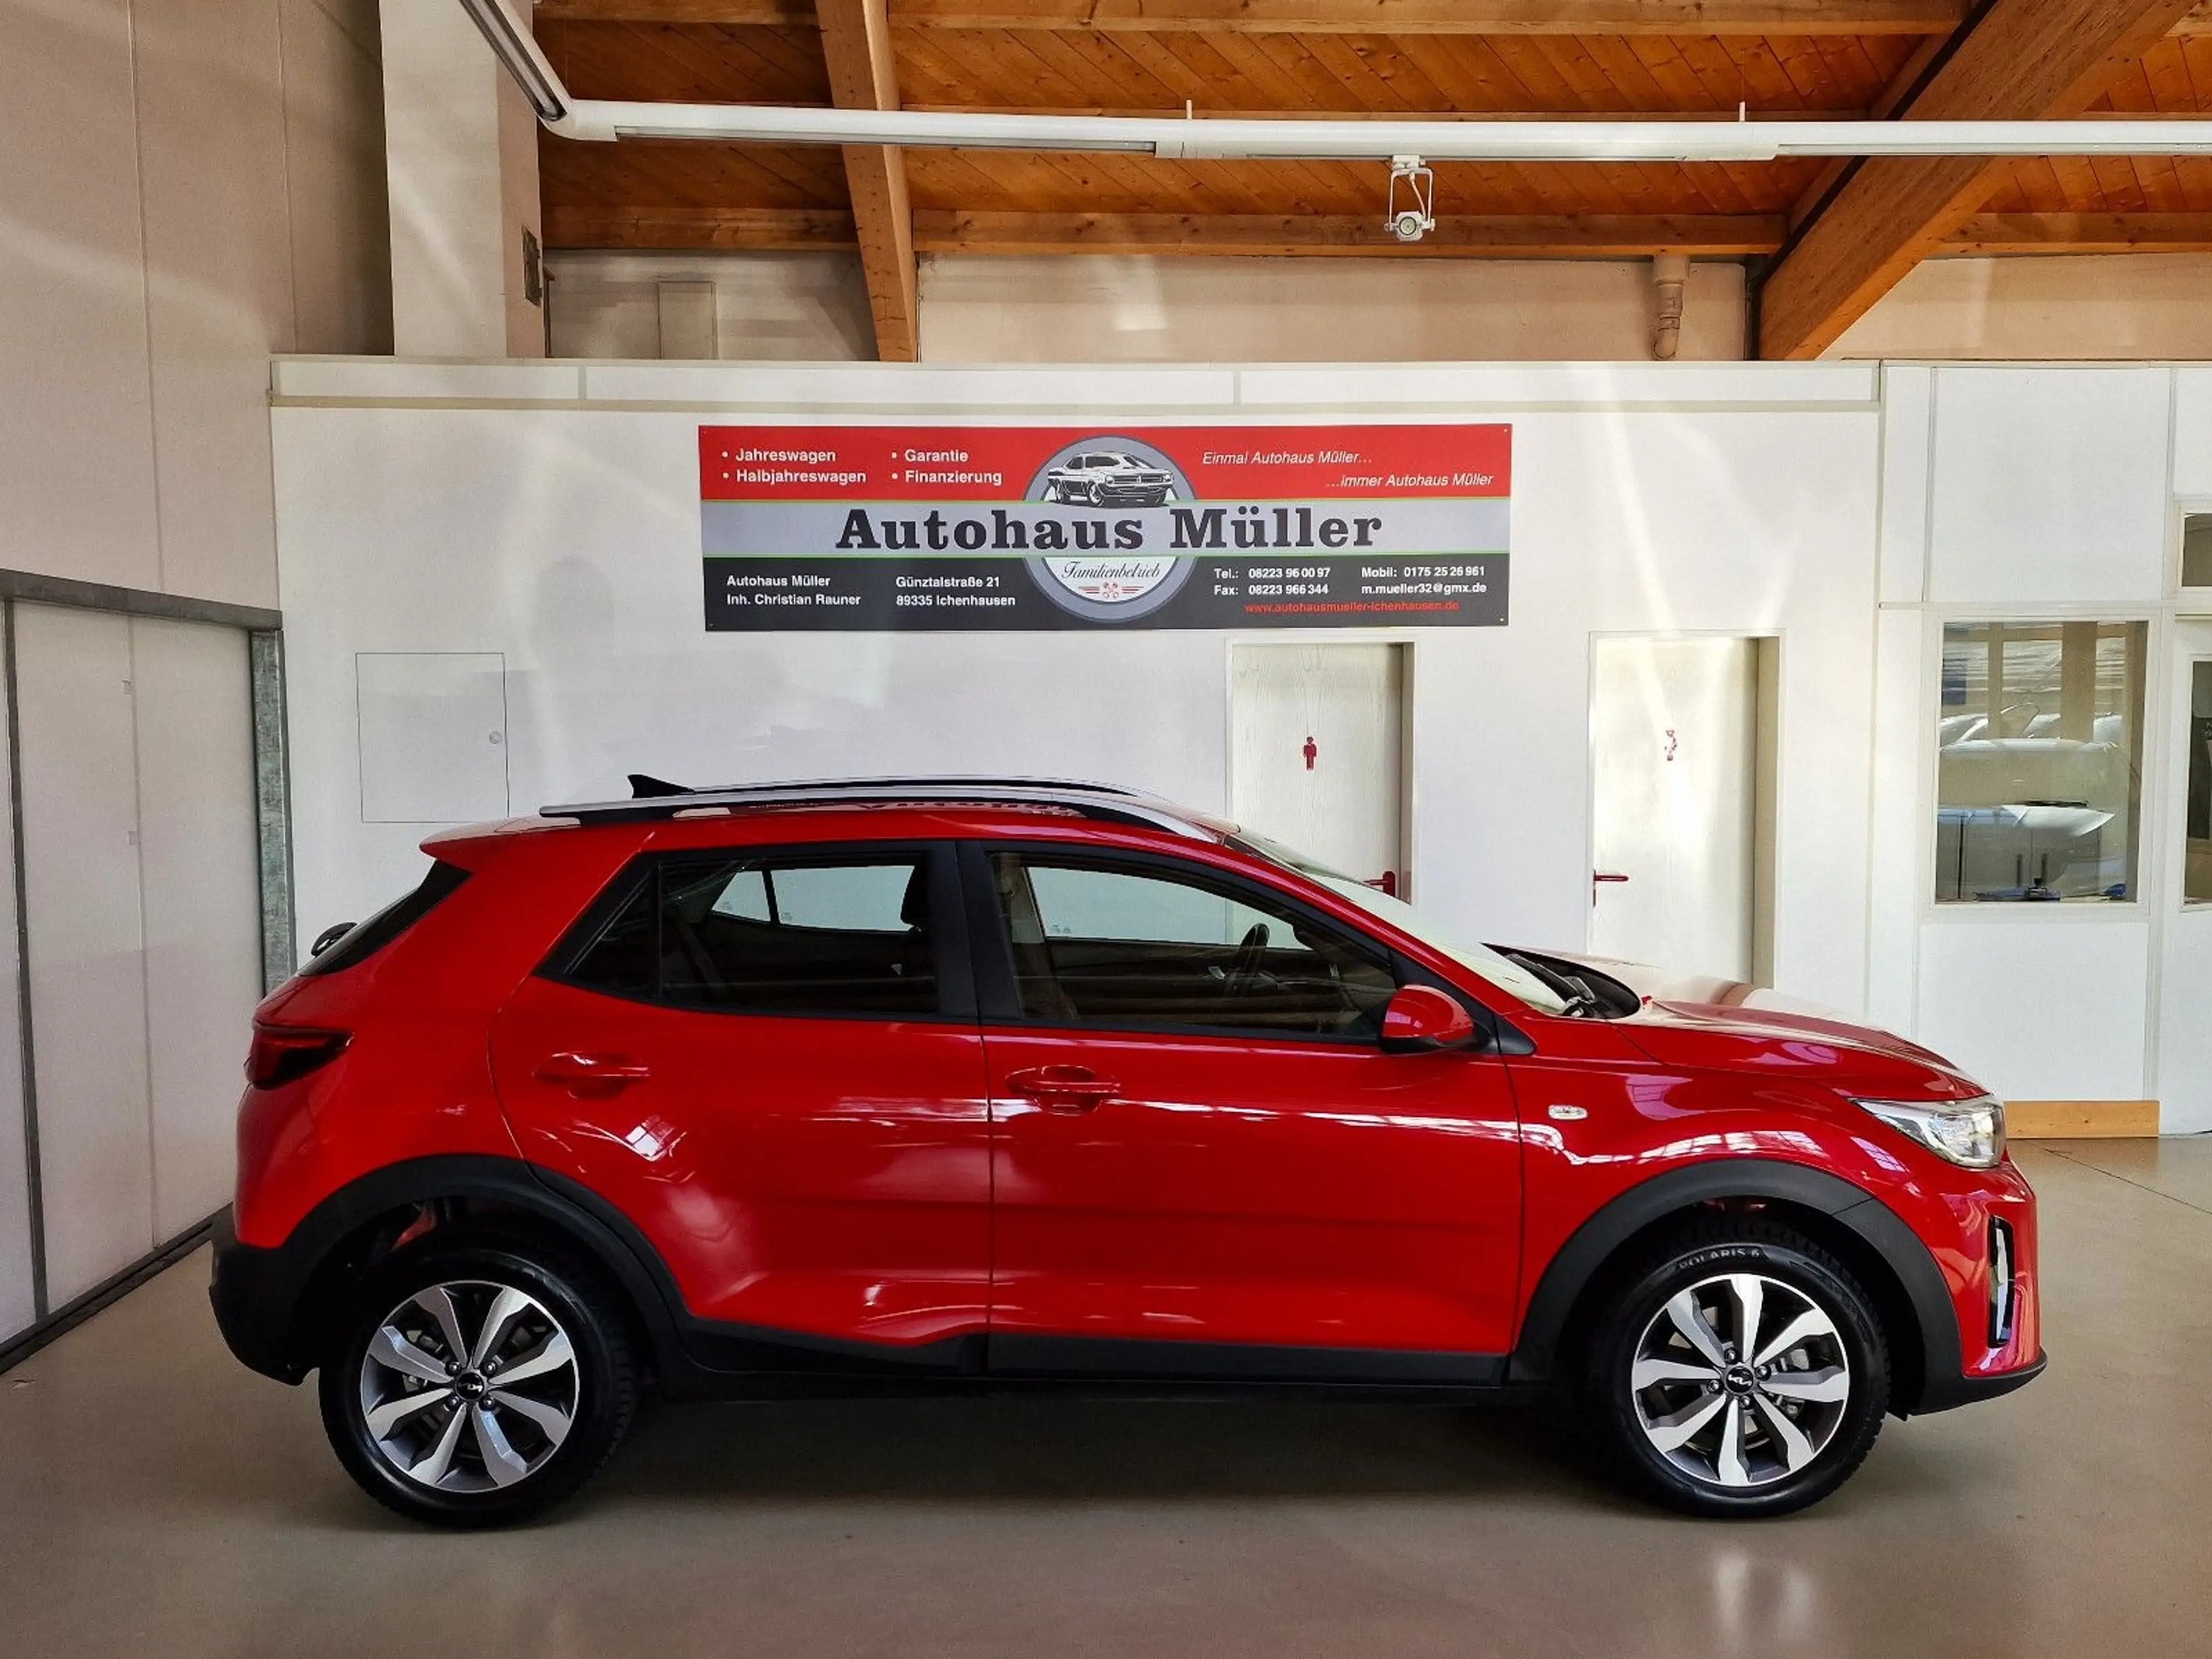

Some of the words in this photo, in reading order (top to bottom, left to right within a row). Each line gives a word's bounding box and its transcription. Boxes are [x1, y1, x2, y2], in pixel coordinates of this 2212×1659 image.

[736, 448, 836, 464] Jahreswagen
[905, 449, 969, 462] Garantie
[1203, 452, 1248, 464] Einmal
[1251, 451, 1314, 464] Autohaus
[737, 469, 866, 485] Halbjahreswagen
[905, 470, 1002, 486] Finanzierung
[1385, 474, 1448, 487] Autohaus
[1452, 472, 1493, 486] Müller
[835, 509, 1143, 550] Autohaus
[1169, 506, 1382, 548] Müller
[1062, 561, 1160, 578] Familienbetrieb
[1214, 568, 1238, 579] Tel.:
[1248, 567, 1282, 578] 08223
[1361, 566, 1397, 578] Mobil:
[1404, 566, 1431, 577] 0175
[727, 575, 788, 586] Autohaus
[791, 575, 830, 586] Müller
[896, 576, 983, 588] Günztalstraße
[986, 576, 999, 587] 21
[1214, 585, 1238, 596] Fax:
[1248, 584, 1282, 595] 08223
[1361, 582, 1487, 596] m.mueller32@gmx.de
[727, 594, 751, 605] Inh.
[755, 594, 812, 605] Christian
[816, 594, 861, 605] Rauner
[896, 594, 933, 606] 89335
[937, 594, 1016, 606] Ichenhausen
[1244, 601, 1460, 613] www.autohausmueller-ichenhausen.de
